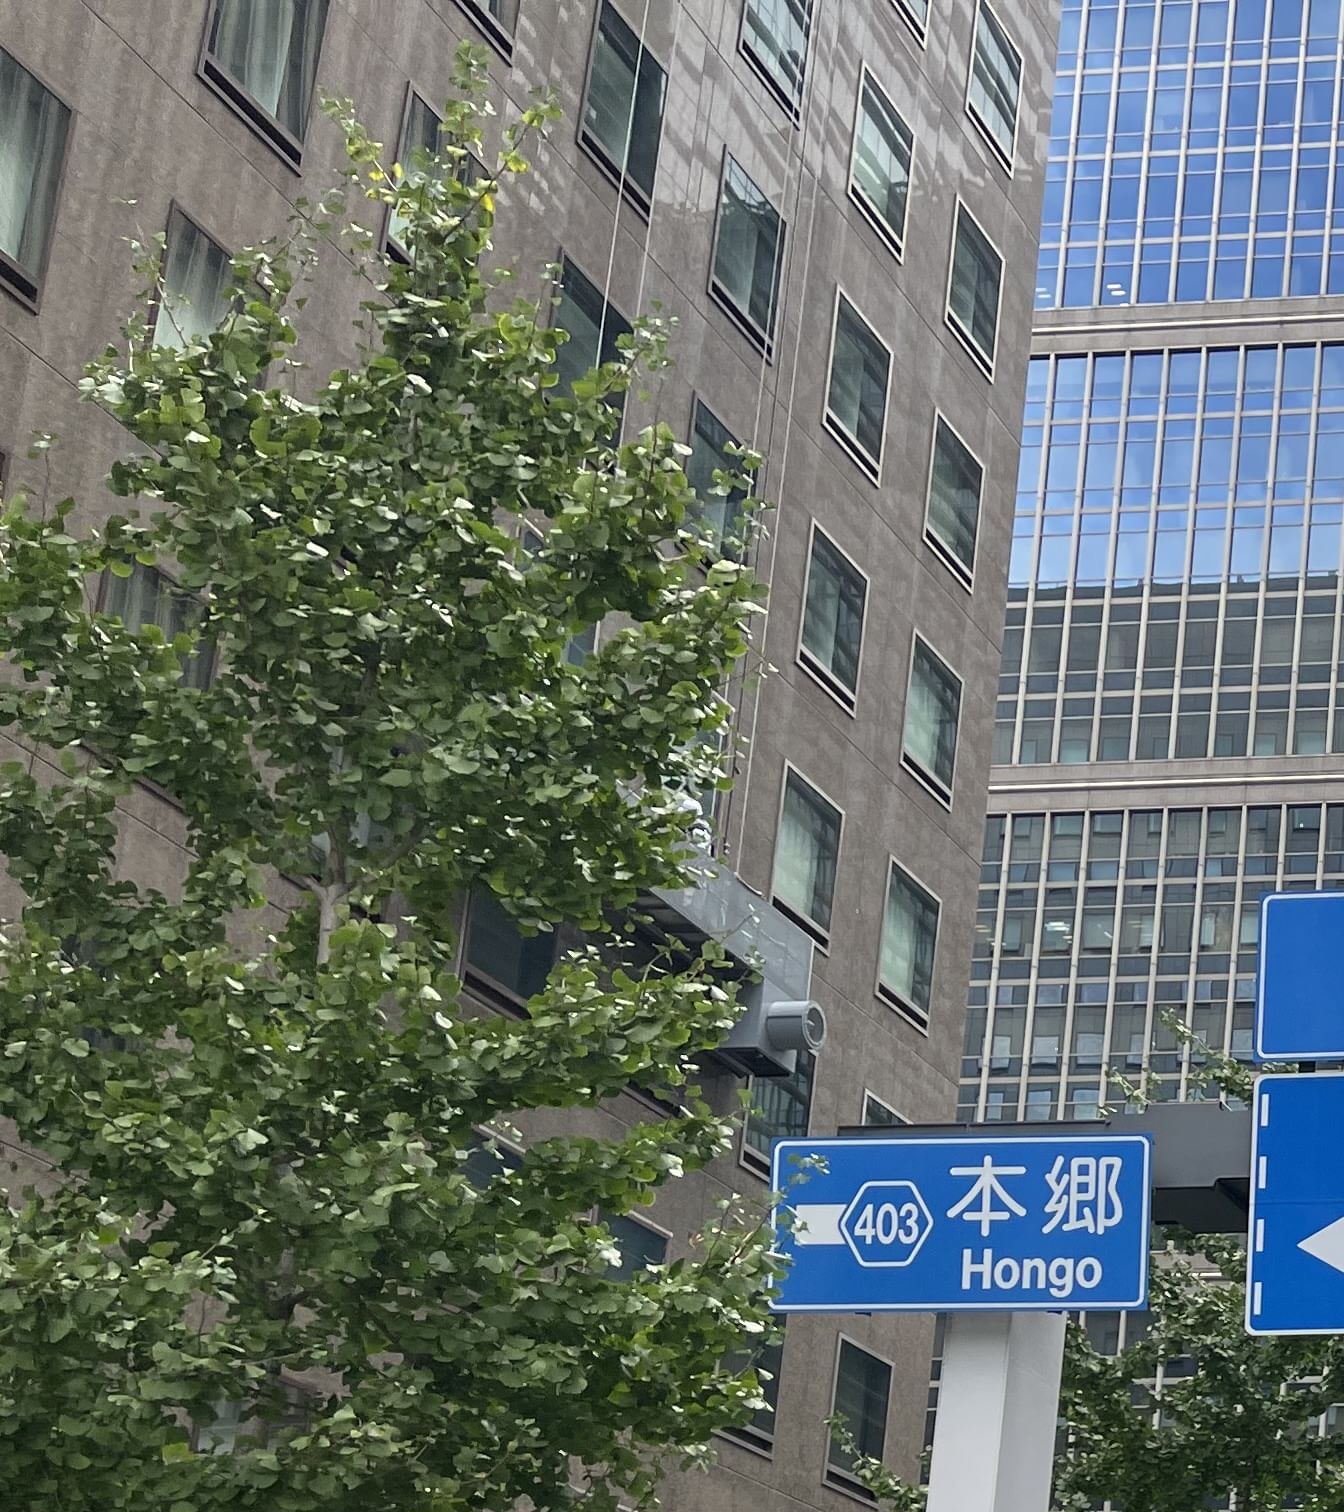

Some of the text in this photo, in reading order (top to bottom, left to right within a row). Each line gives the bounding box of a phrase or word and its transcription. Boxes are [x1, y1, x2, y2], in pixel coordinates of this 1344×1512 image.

[946, 1154, 1124, 1237] 本郷
[853, 1202, 920, 1247] 403
[961, 1248, 1103, 1298] Hongo
